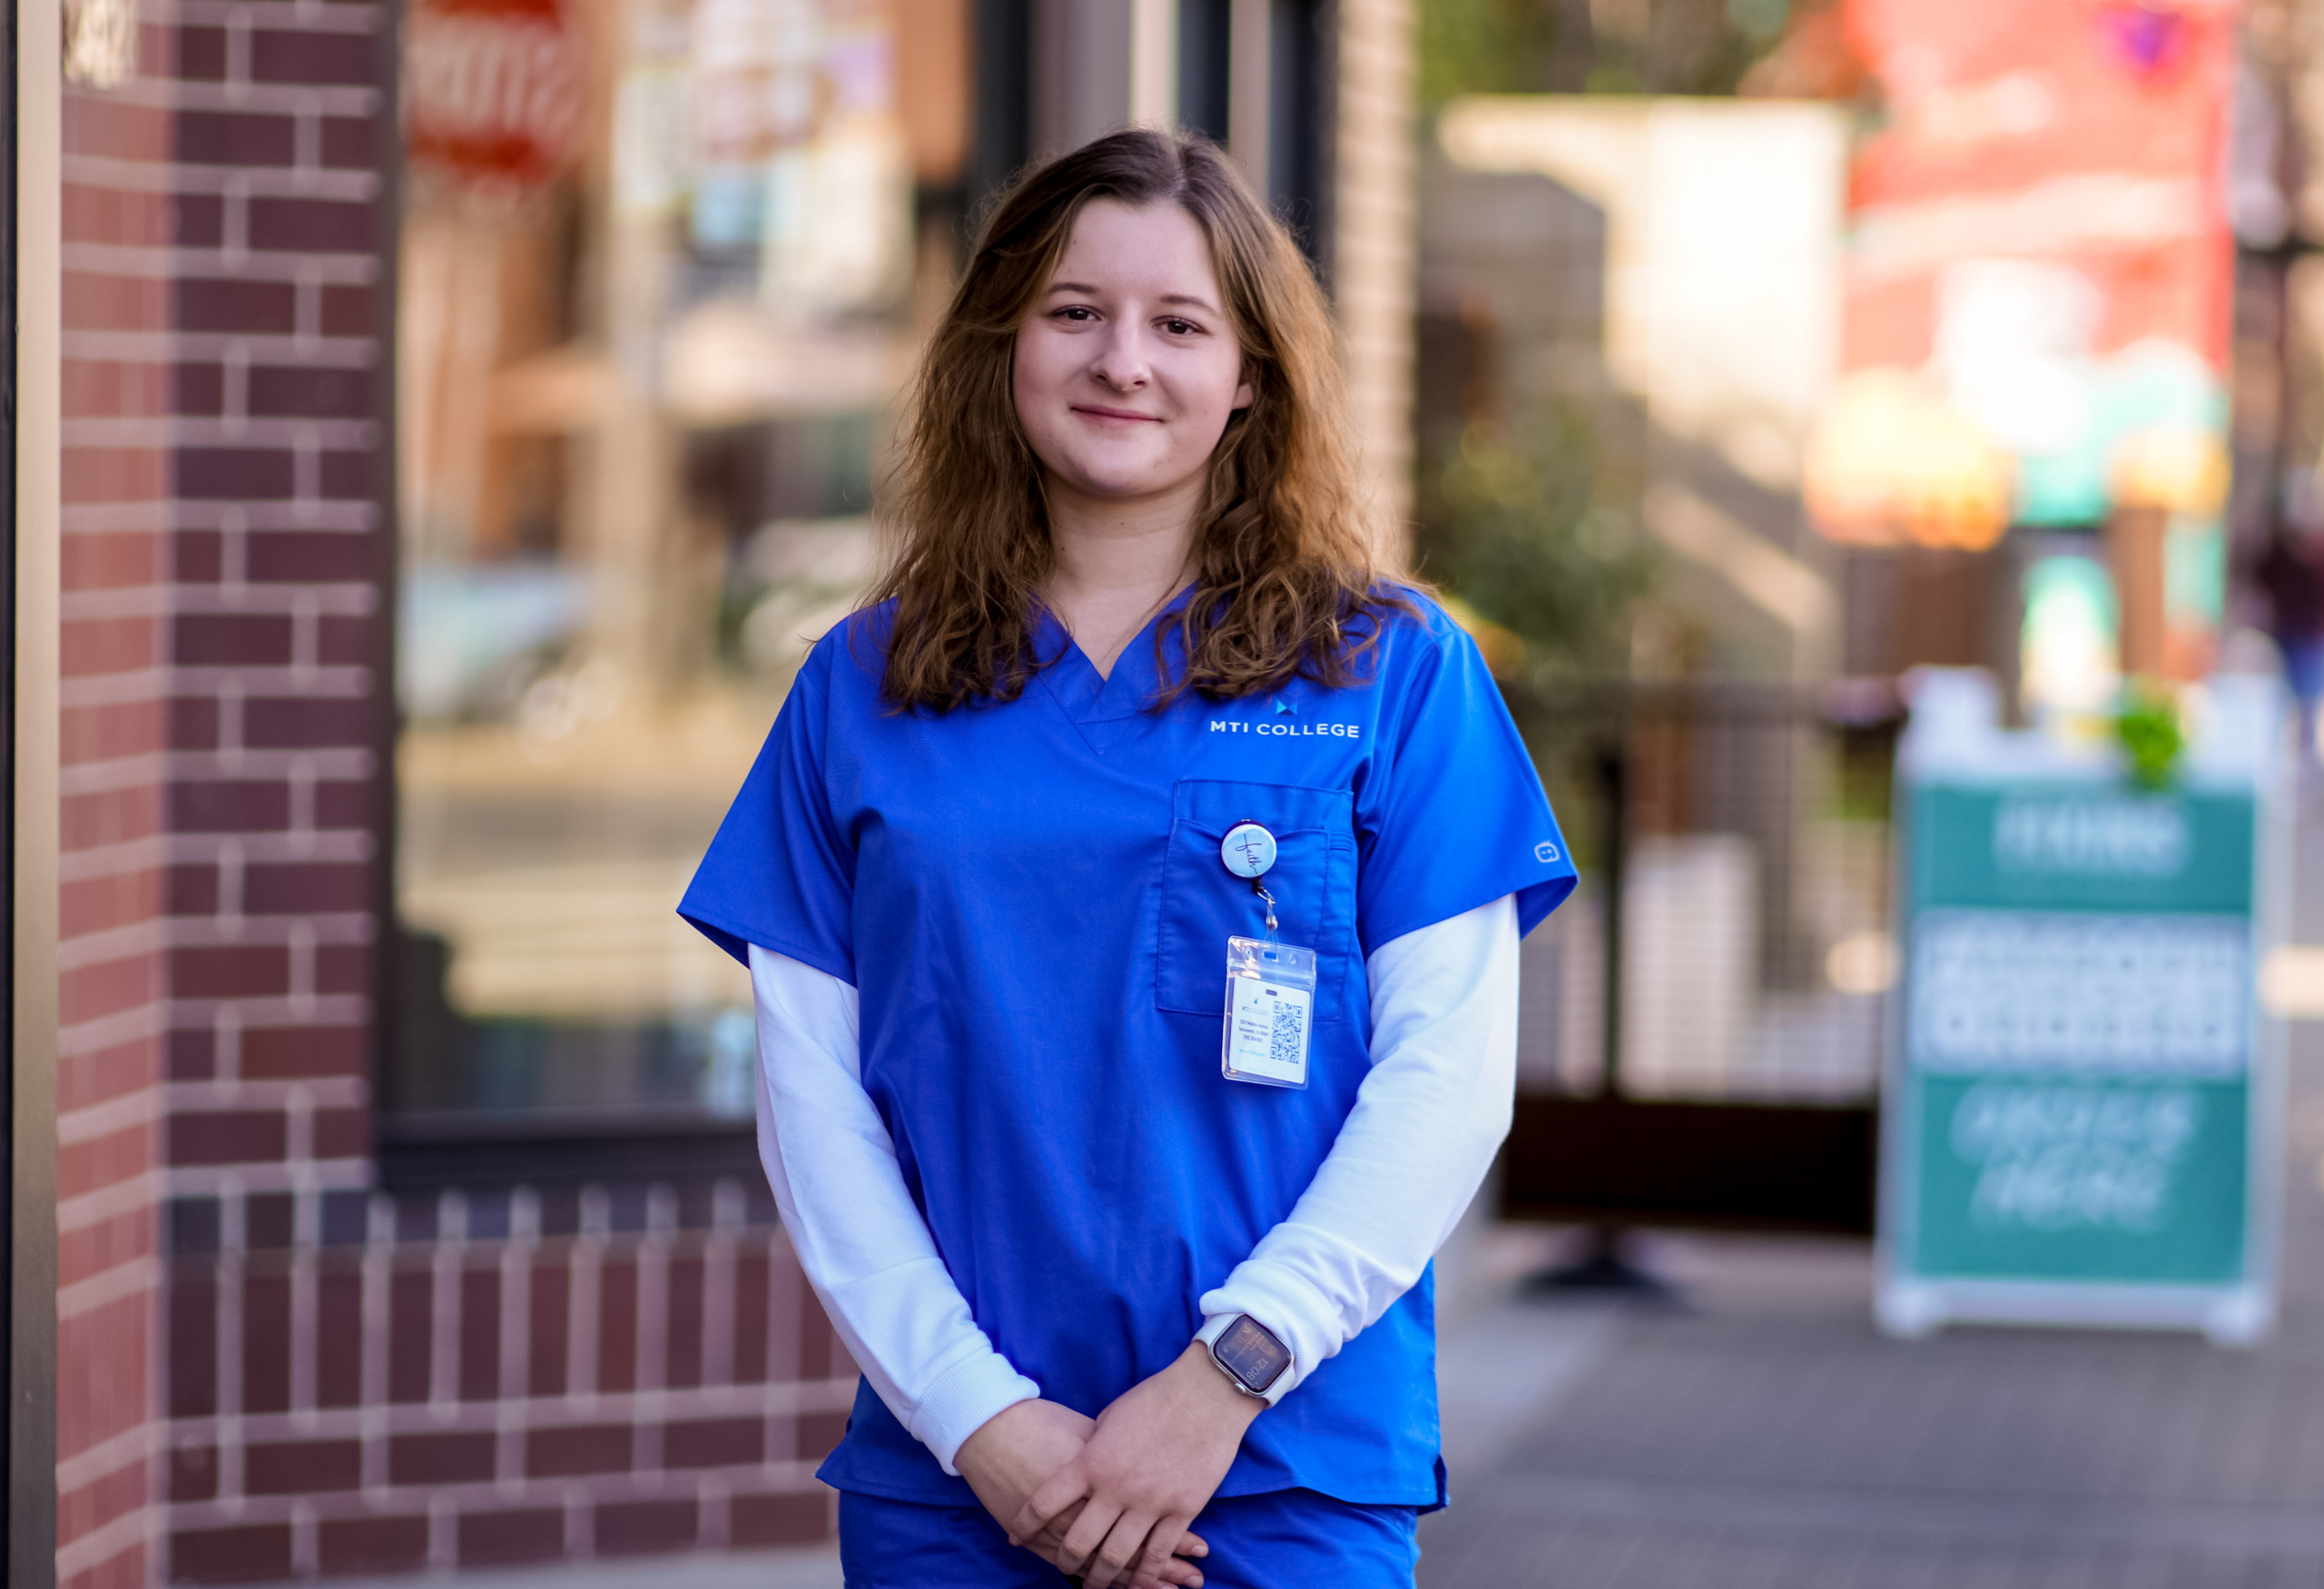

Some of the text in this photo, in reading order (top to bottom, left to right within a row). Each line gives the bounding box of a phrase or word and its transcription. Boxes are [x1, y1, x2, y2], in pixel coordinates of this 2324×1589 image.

[1210, 720, 1360, 738] MTI COLLEGE
[1246, 1357, 1269, 1381] 12:08
